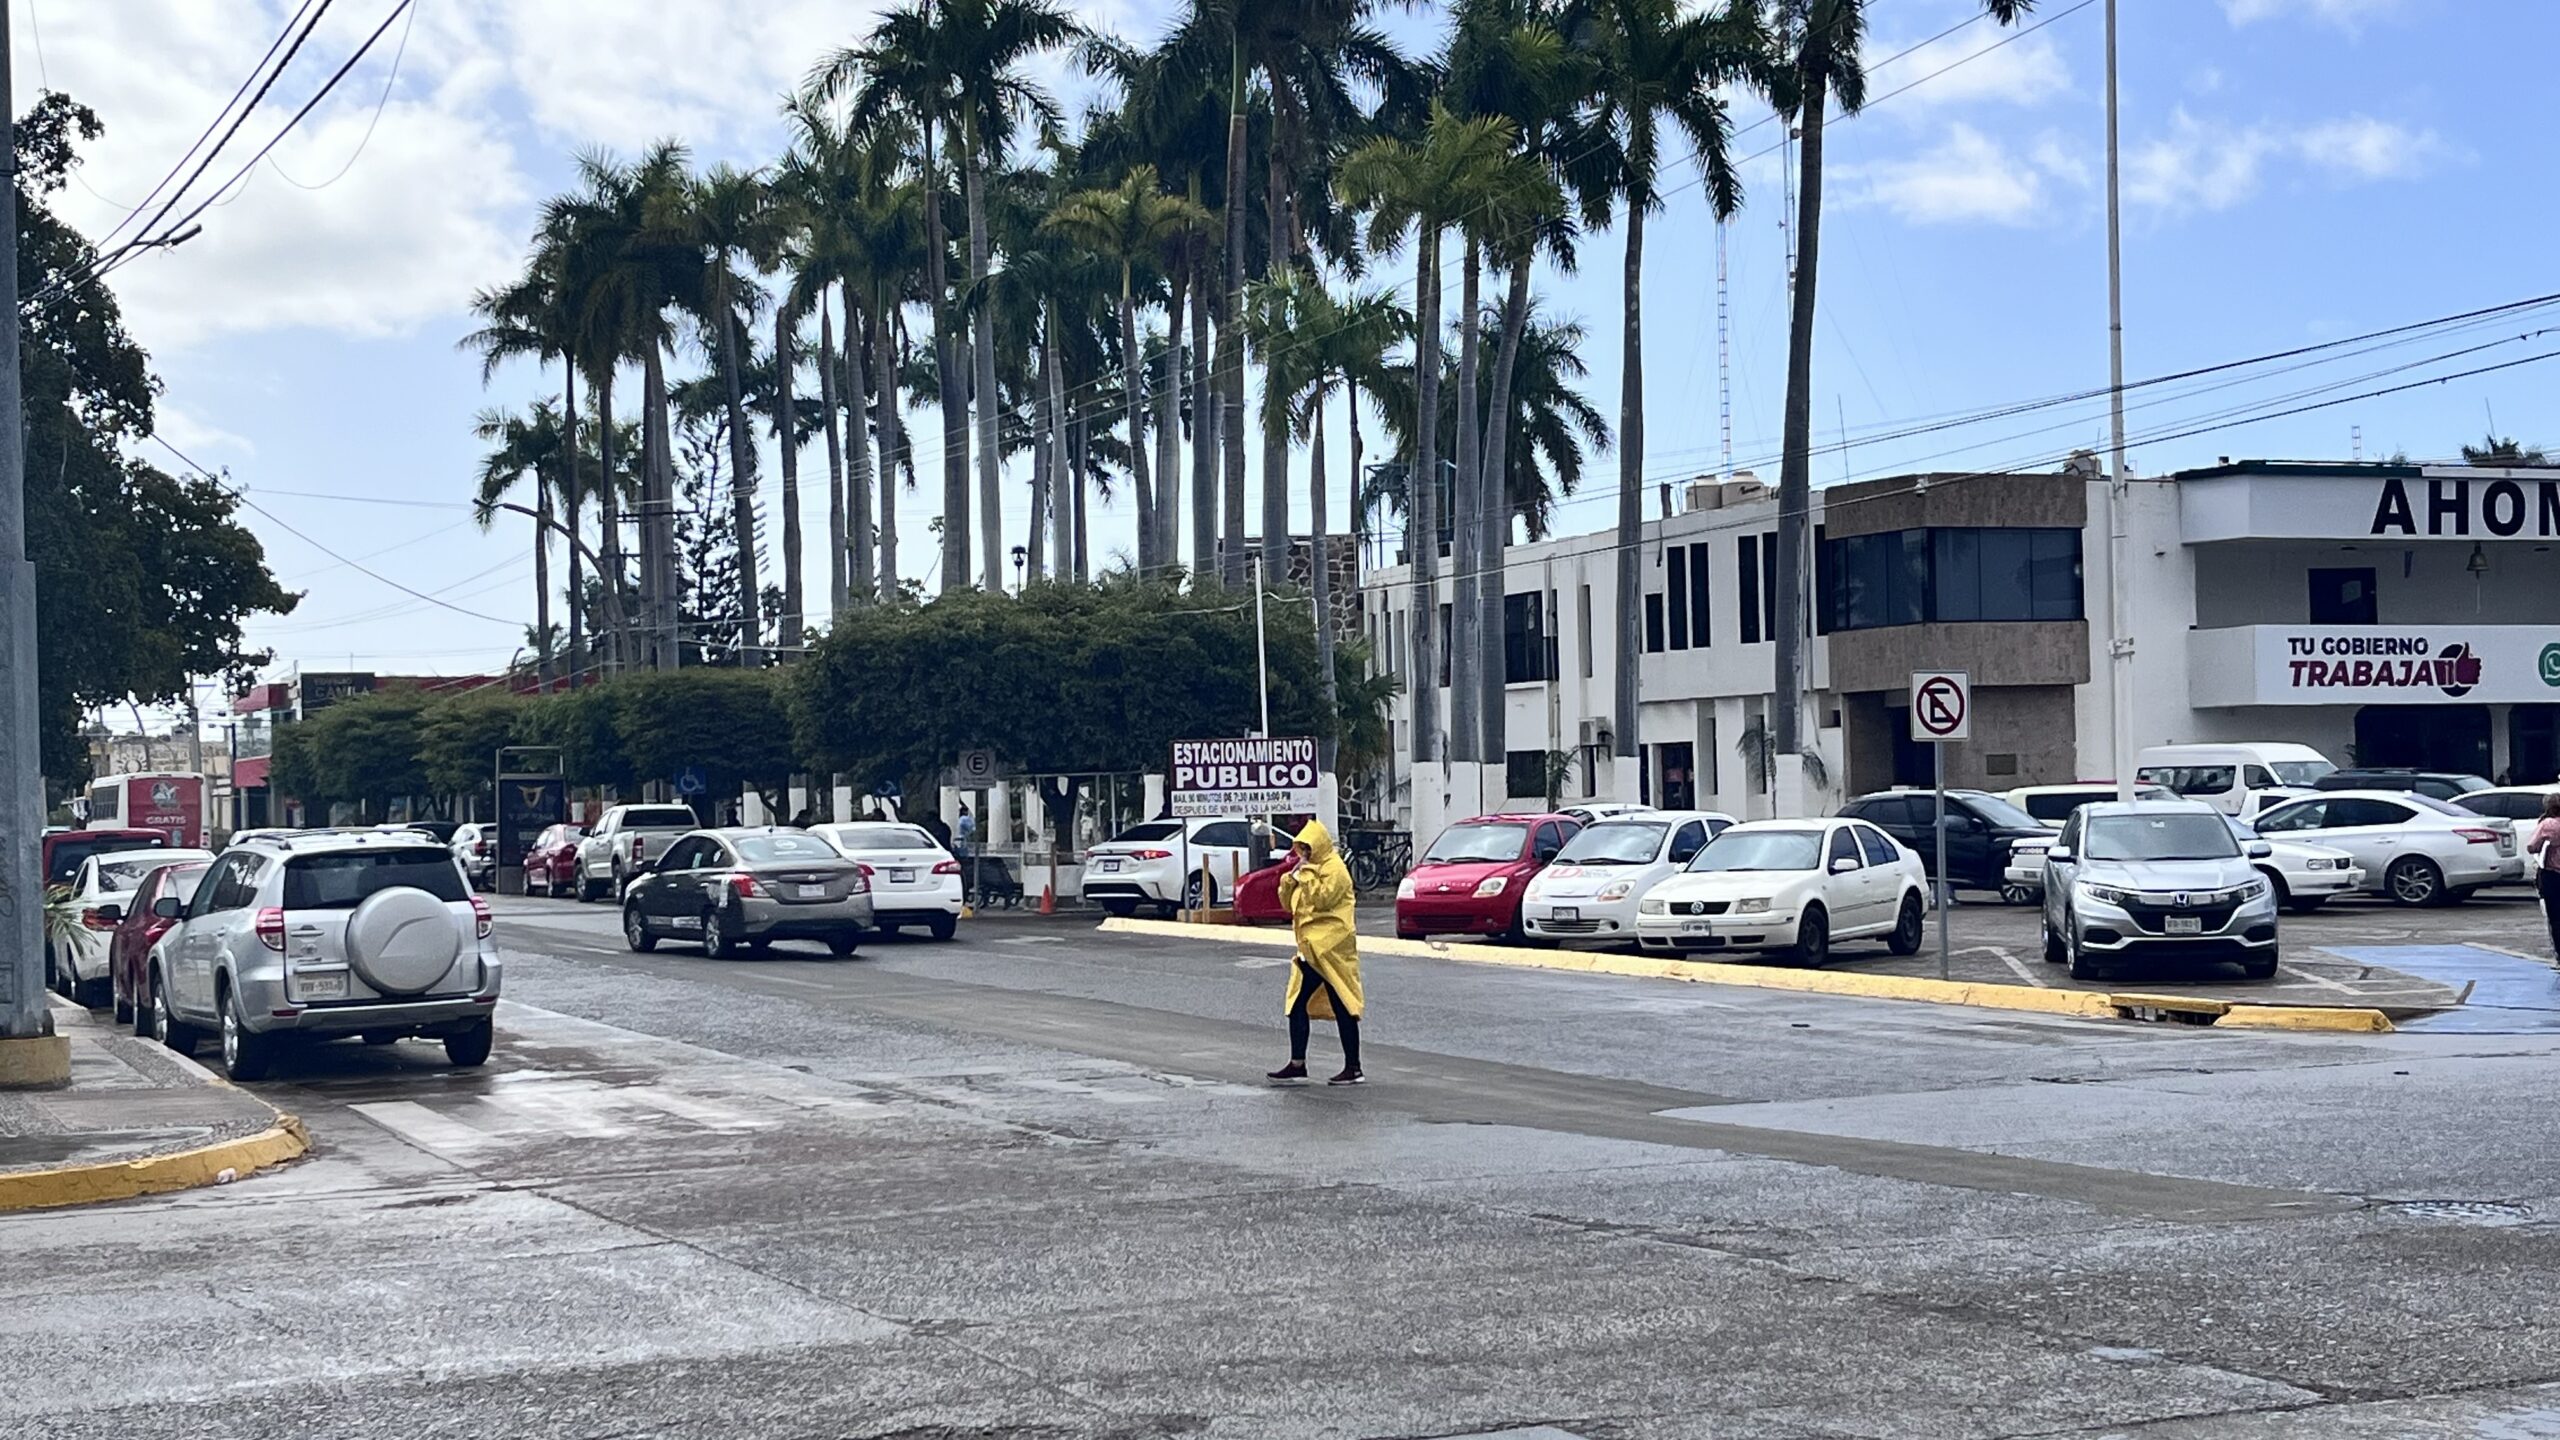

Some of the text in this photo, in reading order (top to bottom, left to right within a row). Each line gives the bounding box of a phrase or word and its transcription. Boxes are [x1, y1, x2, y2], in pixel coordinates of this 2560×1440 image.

[2288, 637, 2429, 655] TU GOBIERNO
[2289, 660, 2434, 687] TRABAJA
[1173, 739, 1313, 765] ESTACIONAMIENTO
[973, 756, 983, 770] E
[1175, 764, 1312, 789] PUBLICO
[1223, 792, 1232, 803] DE
[1249, 792, 1259, 801] AM
[1281, 791, 1291, 800] PM
[1174, 805, 1206, 815] DESPUES
[1208, 805, 1218, 813] DE
[1261, 803, 1270, 813] LA
[1271, 803, 1292, 812] HORA
[145, 815, 187, 825] GRATIS
